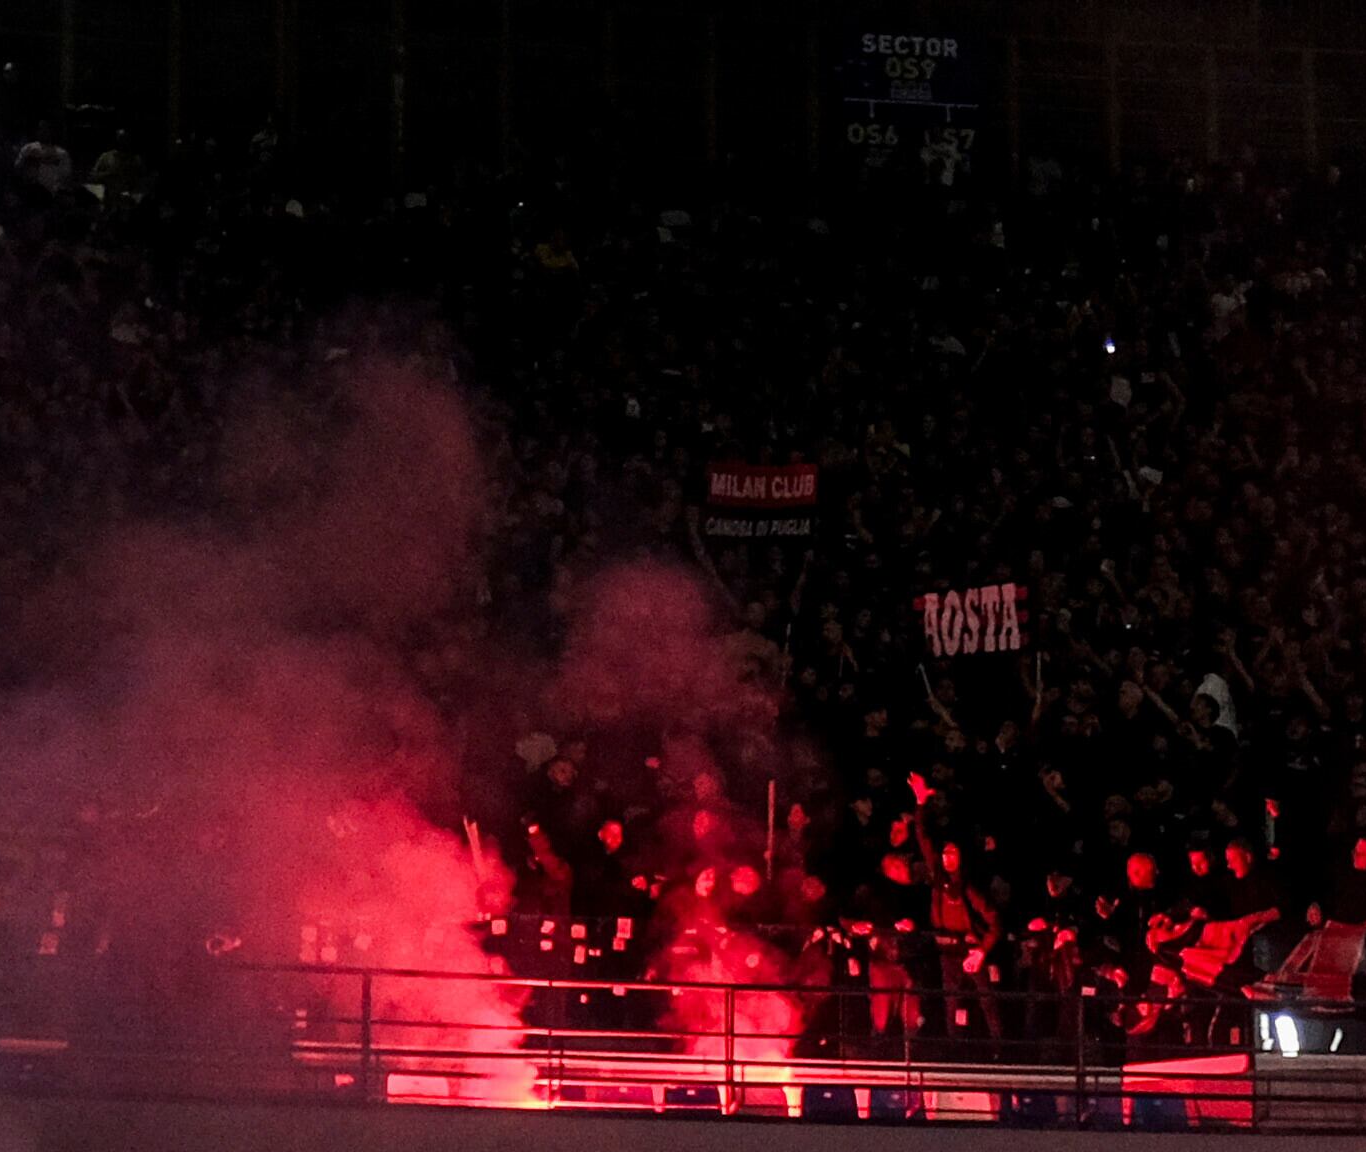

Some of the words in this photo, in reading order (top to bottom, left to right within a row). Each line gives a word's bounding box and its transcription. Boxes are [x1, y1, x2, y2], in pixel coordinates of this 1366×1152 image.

[860, 33, 959, 58] SECTOR
[710, 472, 767, 499] MILAN
[771, 473, 815, 500] CLUB
[923, 582, 1022, 658] AOSTA
